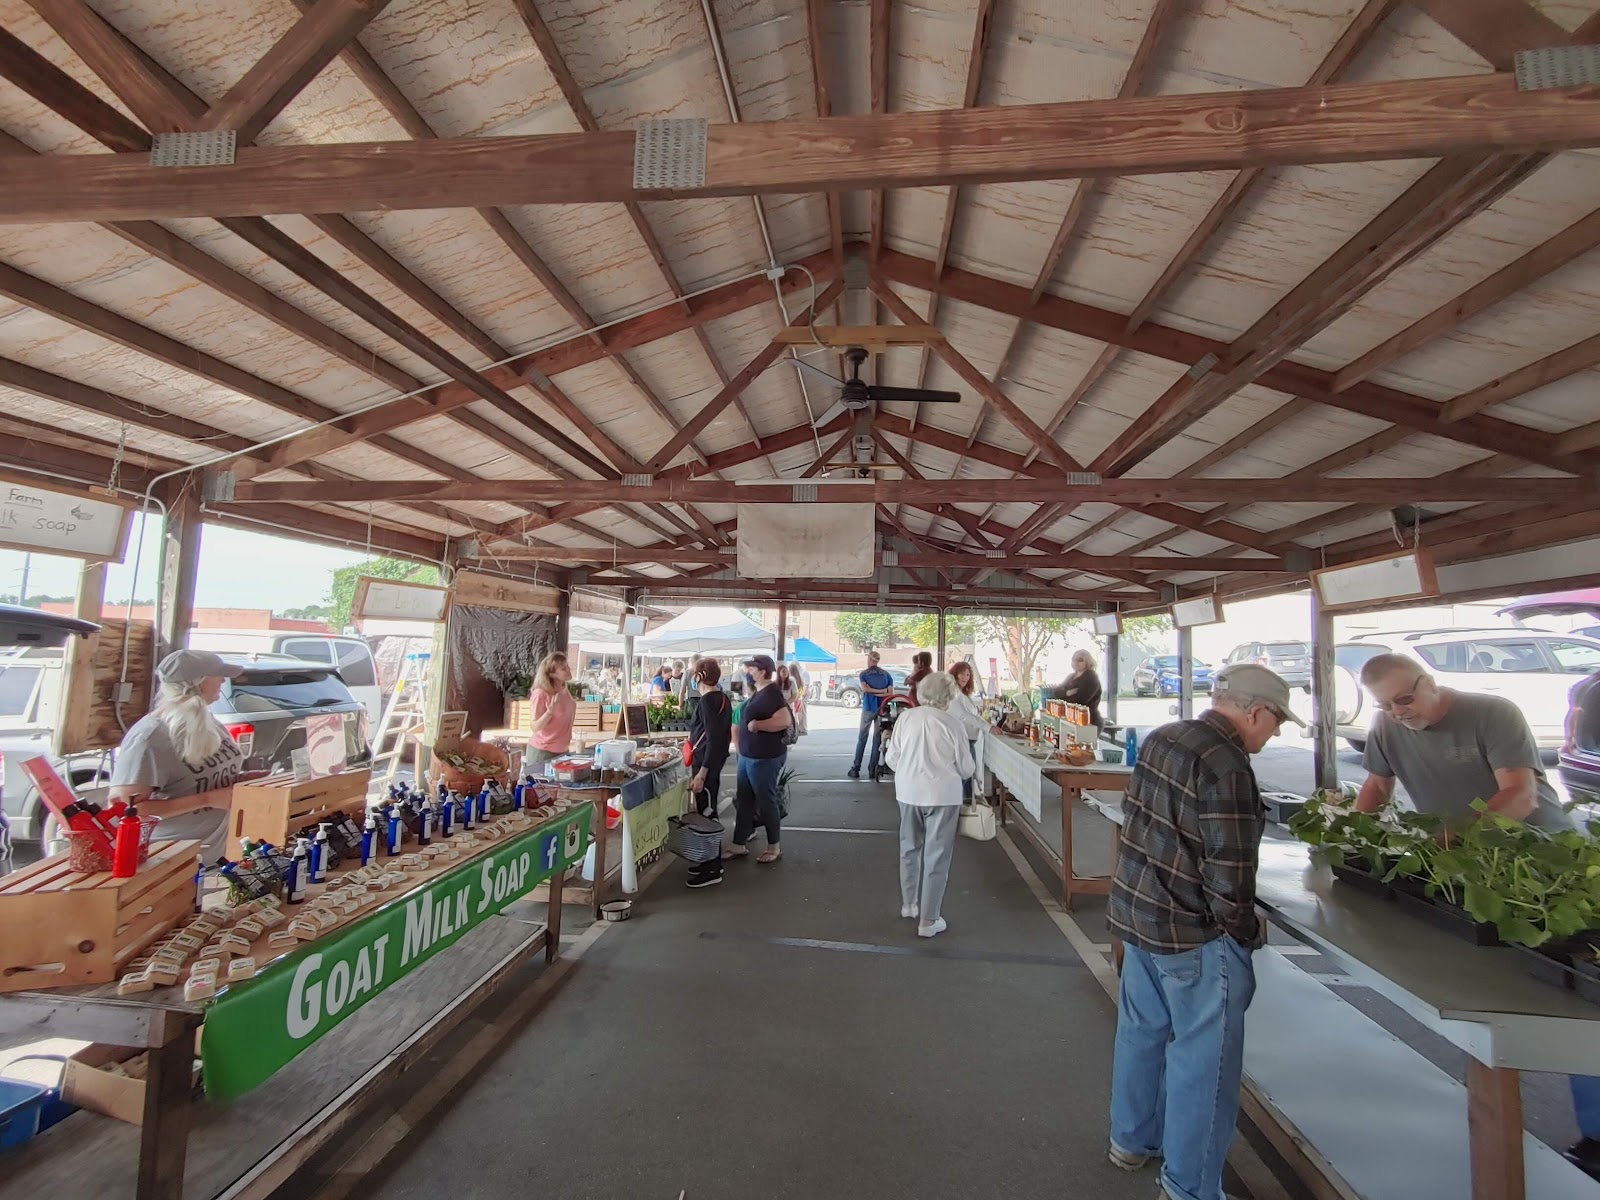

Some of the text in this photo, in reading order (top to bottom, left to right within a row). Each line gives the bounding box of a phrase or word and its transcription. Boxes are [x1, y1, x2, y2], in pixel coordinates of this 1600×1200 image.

[9, 488, 43, 506] Farm
[286, 933, 389, 1039] GOAT
[400, 884, 470, 968] MILK
[477, 852, 530, 913] SOAP
